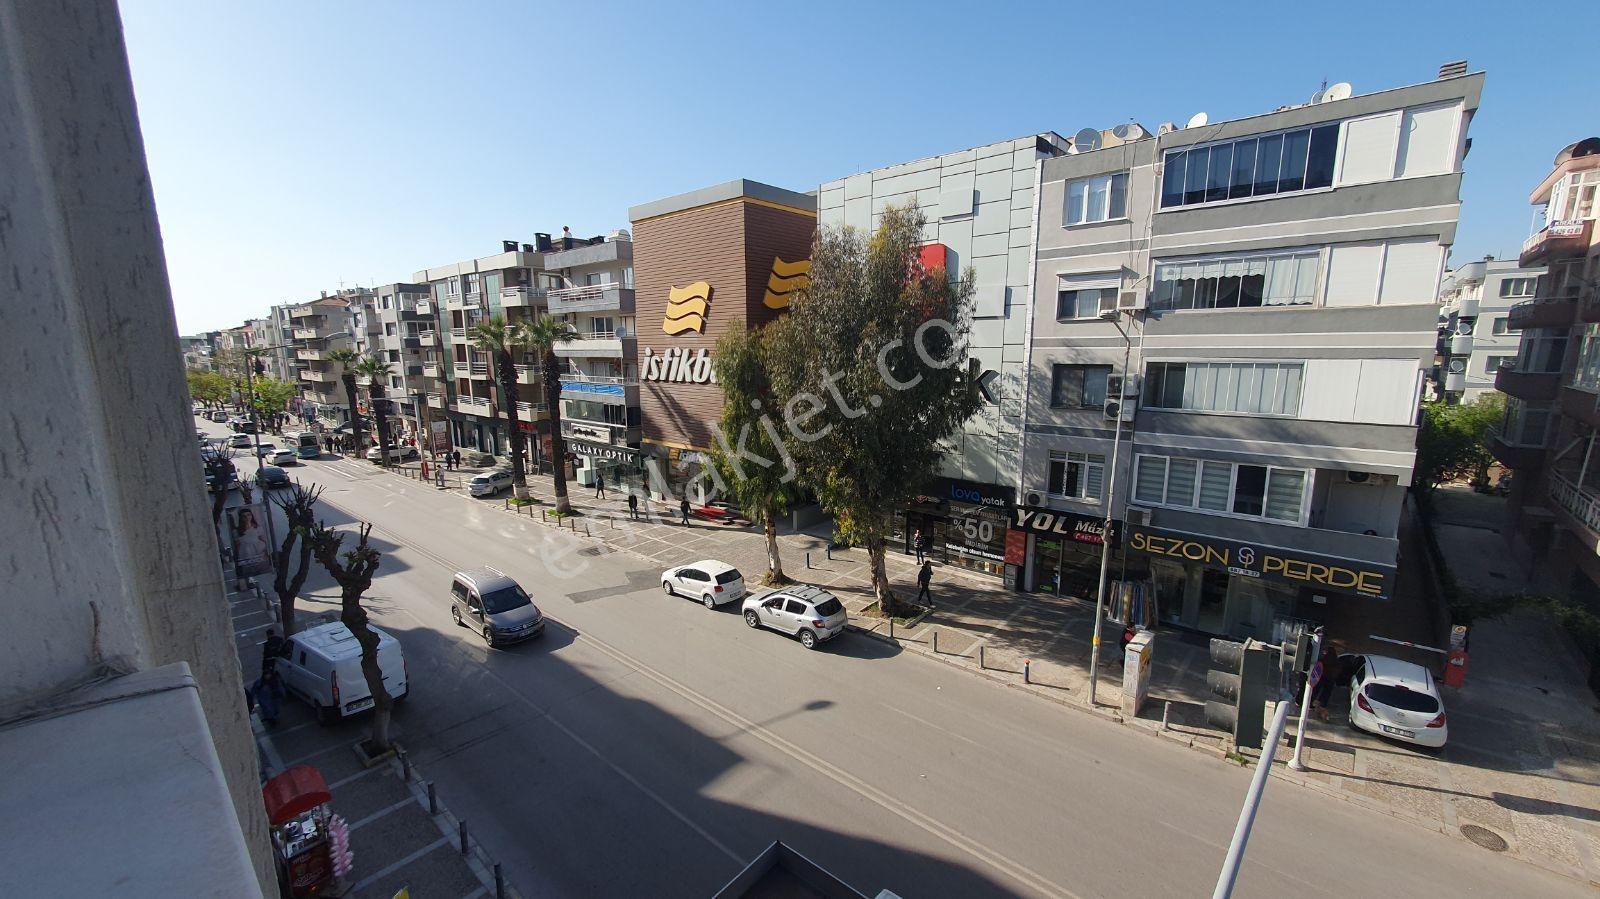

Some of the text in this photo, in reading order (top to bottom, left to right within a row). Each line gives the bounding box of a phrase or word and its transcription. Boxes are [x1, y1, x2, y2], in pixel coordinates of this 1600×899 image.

[571, 443, 603, 457] GALAXY
[981, 496, 1005, 507] yatak
[1017, 508, 1068, 535] YOL
[1130, 532, 1385, 594] SEZON PERDE
